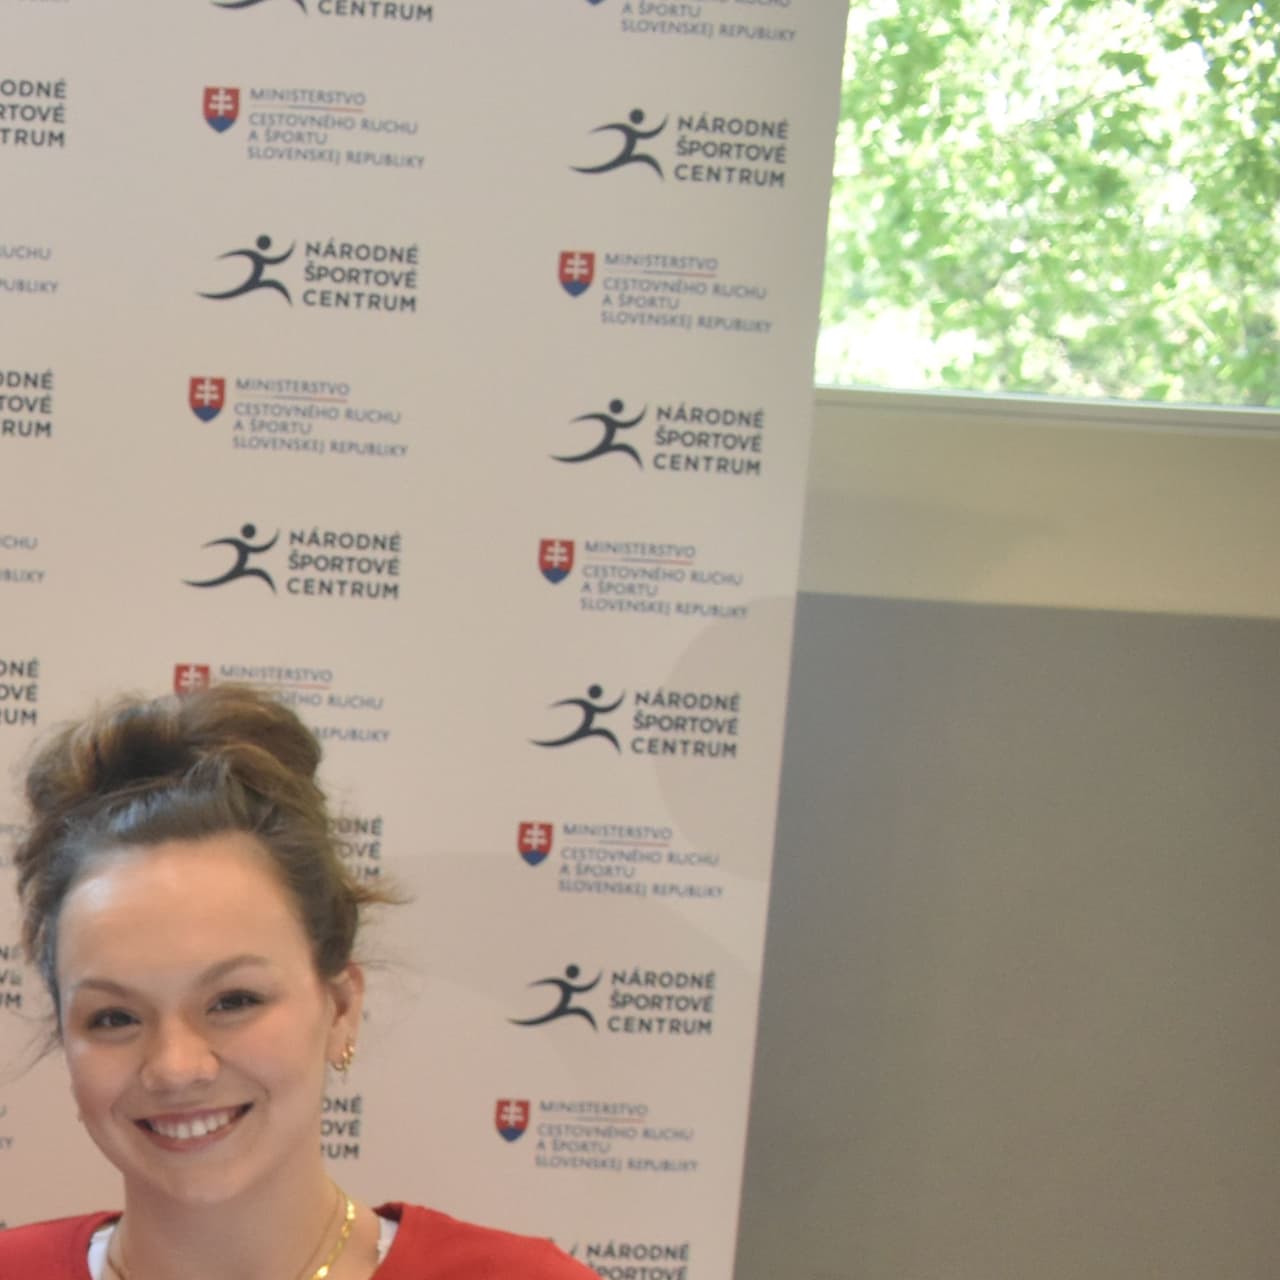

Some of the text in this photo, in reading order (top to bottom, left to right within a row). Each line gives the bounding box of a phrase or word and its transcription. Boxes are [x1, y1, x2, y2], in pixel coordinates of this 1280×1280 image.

[318, 0, 433, 22] CENTRUM
[251, 89, 365, 106] MINISTERSTVO
[265, 128, 326, 145] ŠPORTU
[361, 118, 418, 134] RUCHU
[678, 112, 789, 139] NÁRODNÉ
[247, 146, 424, 167] SLOVENSKEJ REPUBLIKY
[676, 134, 787, 164] ŠPORTOVÉ
[674, 163, 785, 188] CENTRUM
[305, 238, 418, 265] NÁRODNÉ
[606, 254, 717, 271] MINISTERSTVO
[304, 260, 417, 289] ŠPORTOVÉ
[302, 289, 416, 313] CENTRUM
[619, 293, 678, 309] ŠPORTU
[712, 283, 768, 299] RUCHU
[601, 311, 773, 332] SLOVENSKEJ REPUBLIKY
[237, 379, 349, 396] MINISTERSTVO
[250, 418, 311, 434] ŠPORTU
[344, 407, 402, 424] RUCHU
[657, 402, 765, 428] NÁRODNÉ
[233, 436, 407, 456] SLOVENSKEJ REPUBLIKY
[656, 424, 763, 453] ŠPORTOVÉ
[653, 453, 761, 476] CENTRUM
[289, 526, 401, 552] NÁRODNÉ
[288, 549, 399, 576] ŠPORTOVÉ
[286, 577, 398, 600] CENTRUM
[635, 687, 741, 712] NÁRODNÉ
[634, 709, 739, 735] ŠPORTOVÉ
[631, 737, 737, 759] CENTRUM
[612, 967, 717, 990] NÁRODNÉ
[610, 989, 715, 1013] ŠPORTOVÉ
[608, 1016, 713, 1035] CENTRUM
[587, 1239, 690, 1261] NÁRODNÉ
